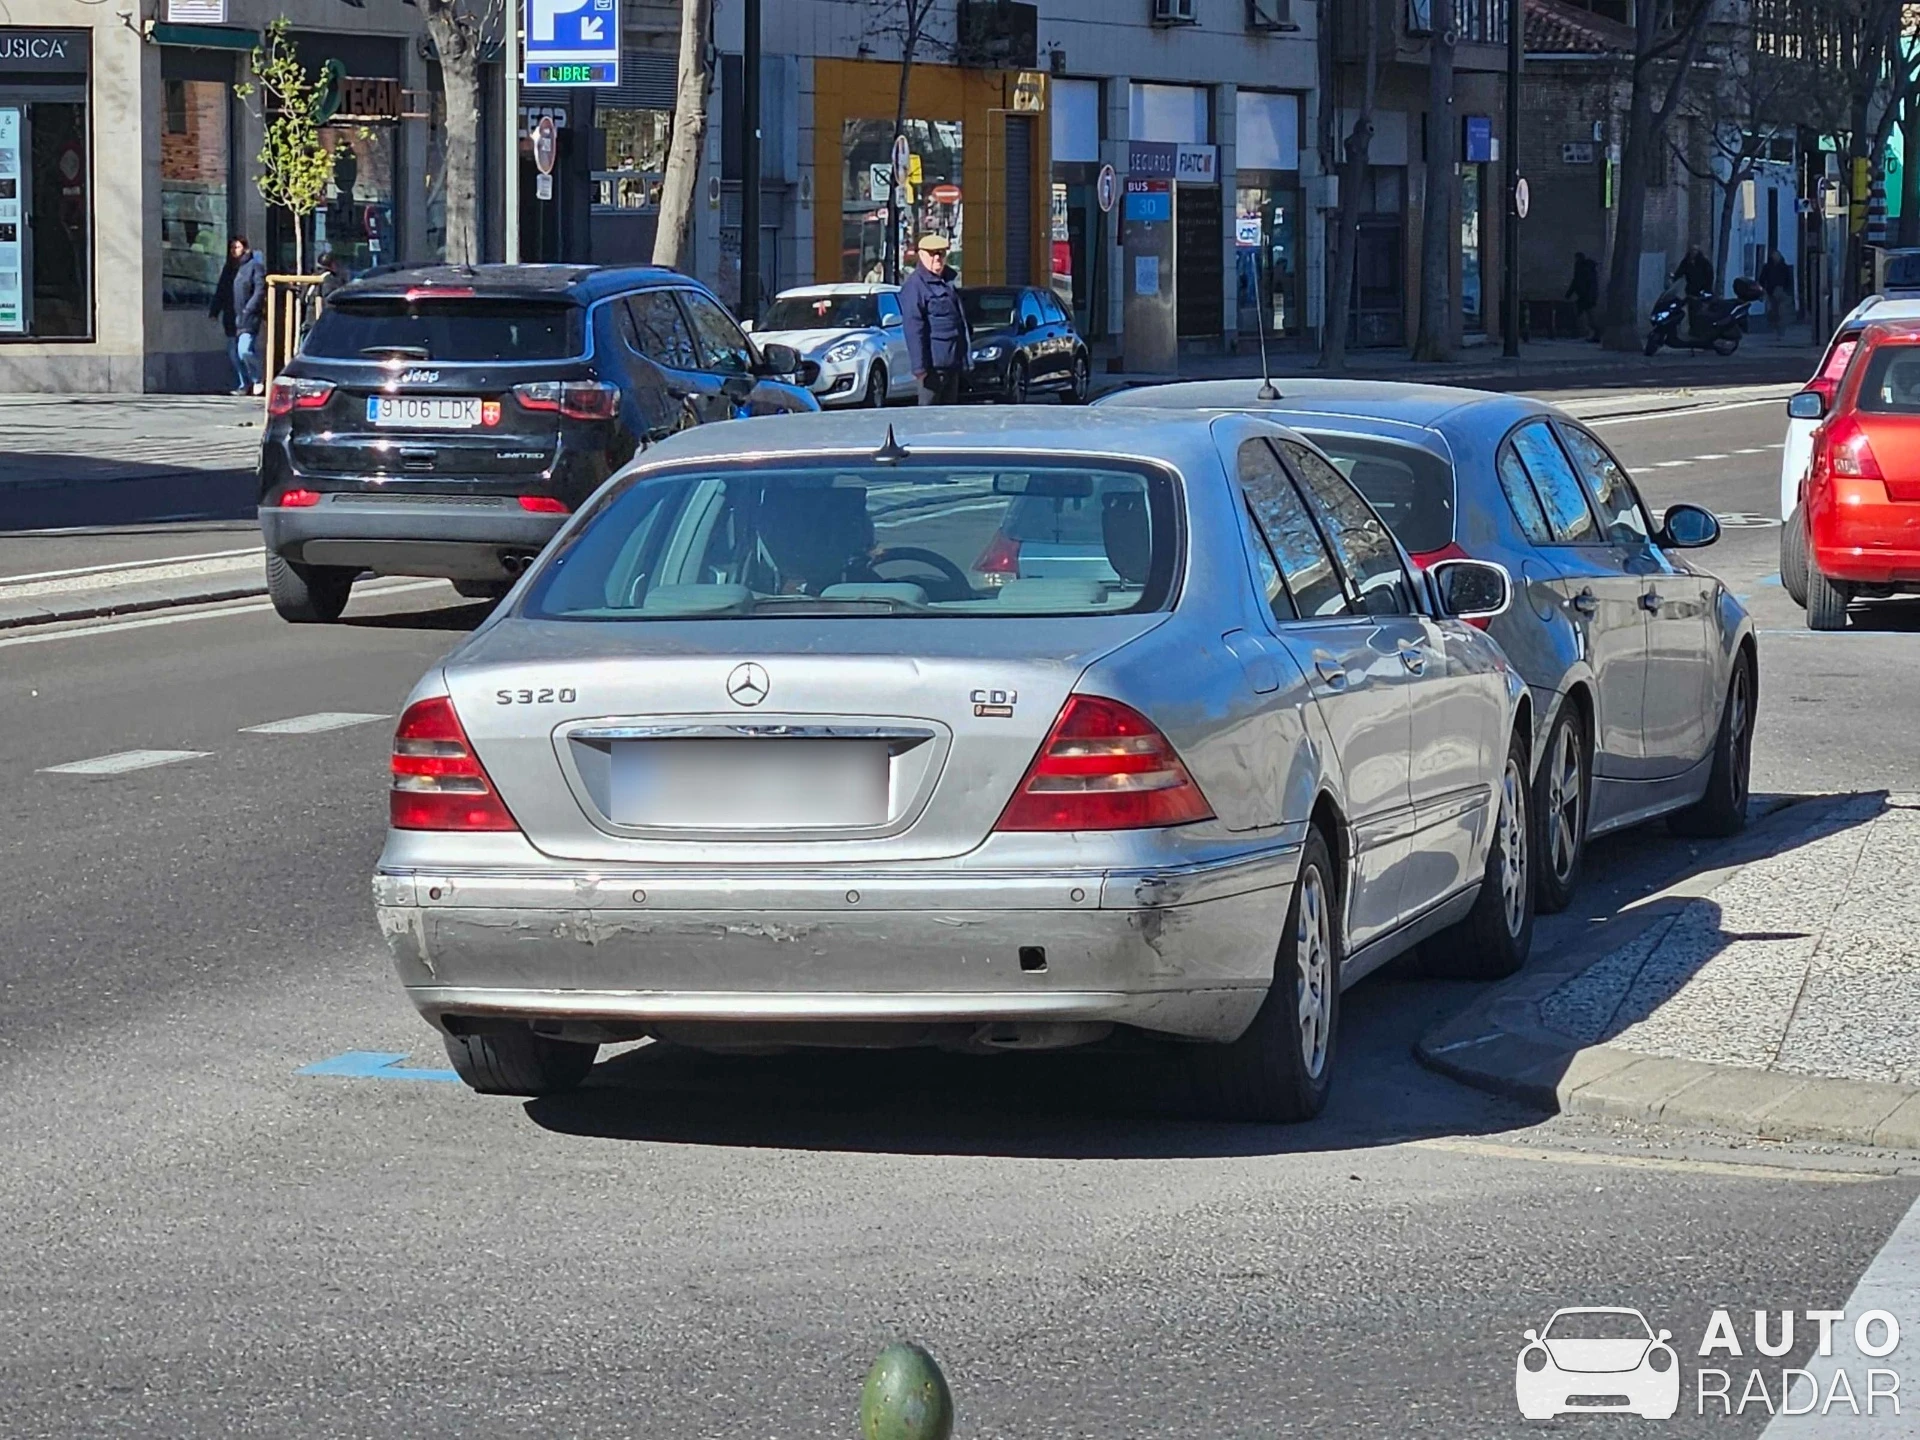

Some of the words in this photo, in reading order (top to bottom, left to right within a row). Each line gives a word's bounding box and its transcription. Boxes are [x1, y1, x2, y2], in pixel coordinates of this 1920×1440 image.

[549, 66, 591, 81] LIBRE
[1130, 153, 1171, 172] SEGUROS
[1128, 182, 1149, 192] BUS
[1139, 199, 1156, 215] 30
[402, 369, 440, 383] Jeep
[382, 400, 431, 419] 9106
[439, 400, 475, 420] LDK
[496, 688, 577, 705] S320
